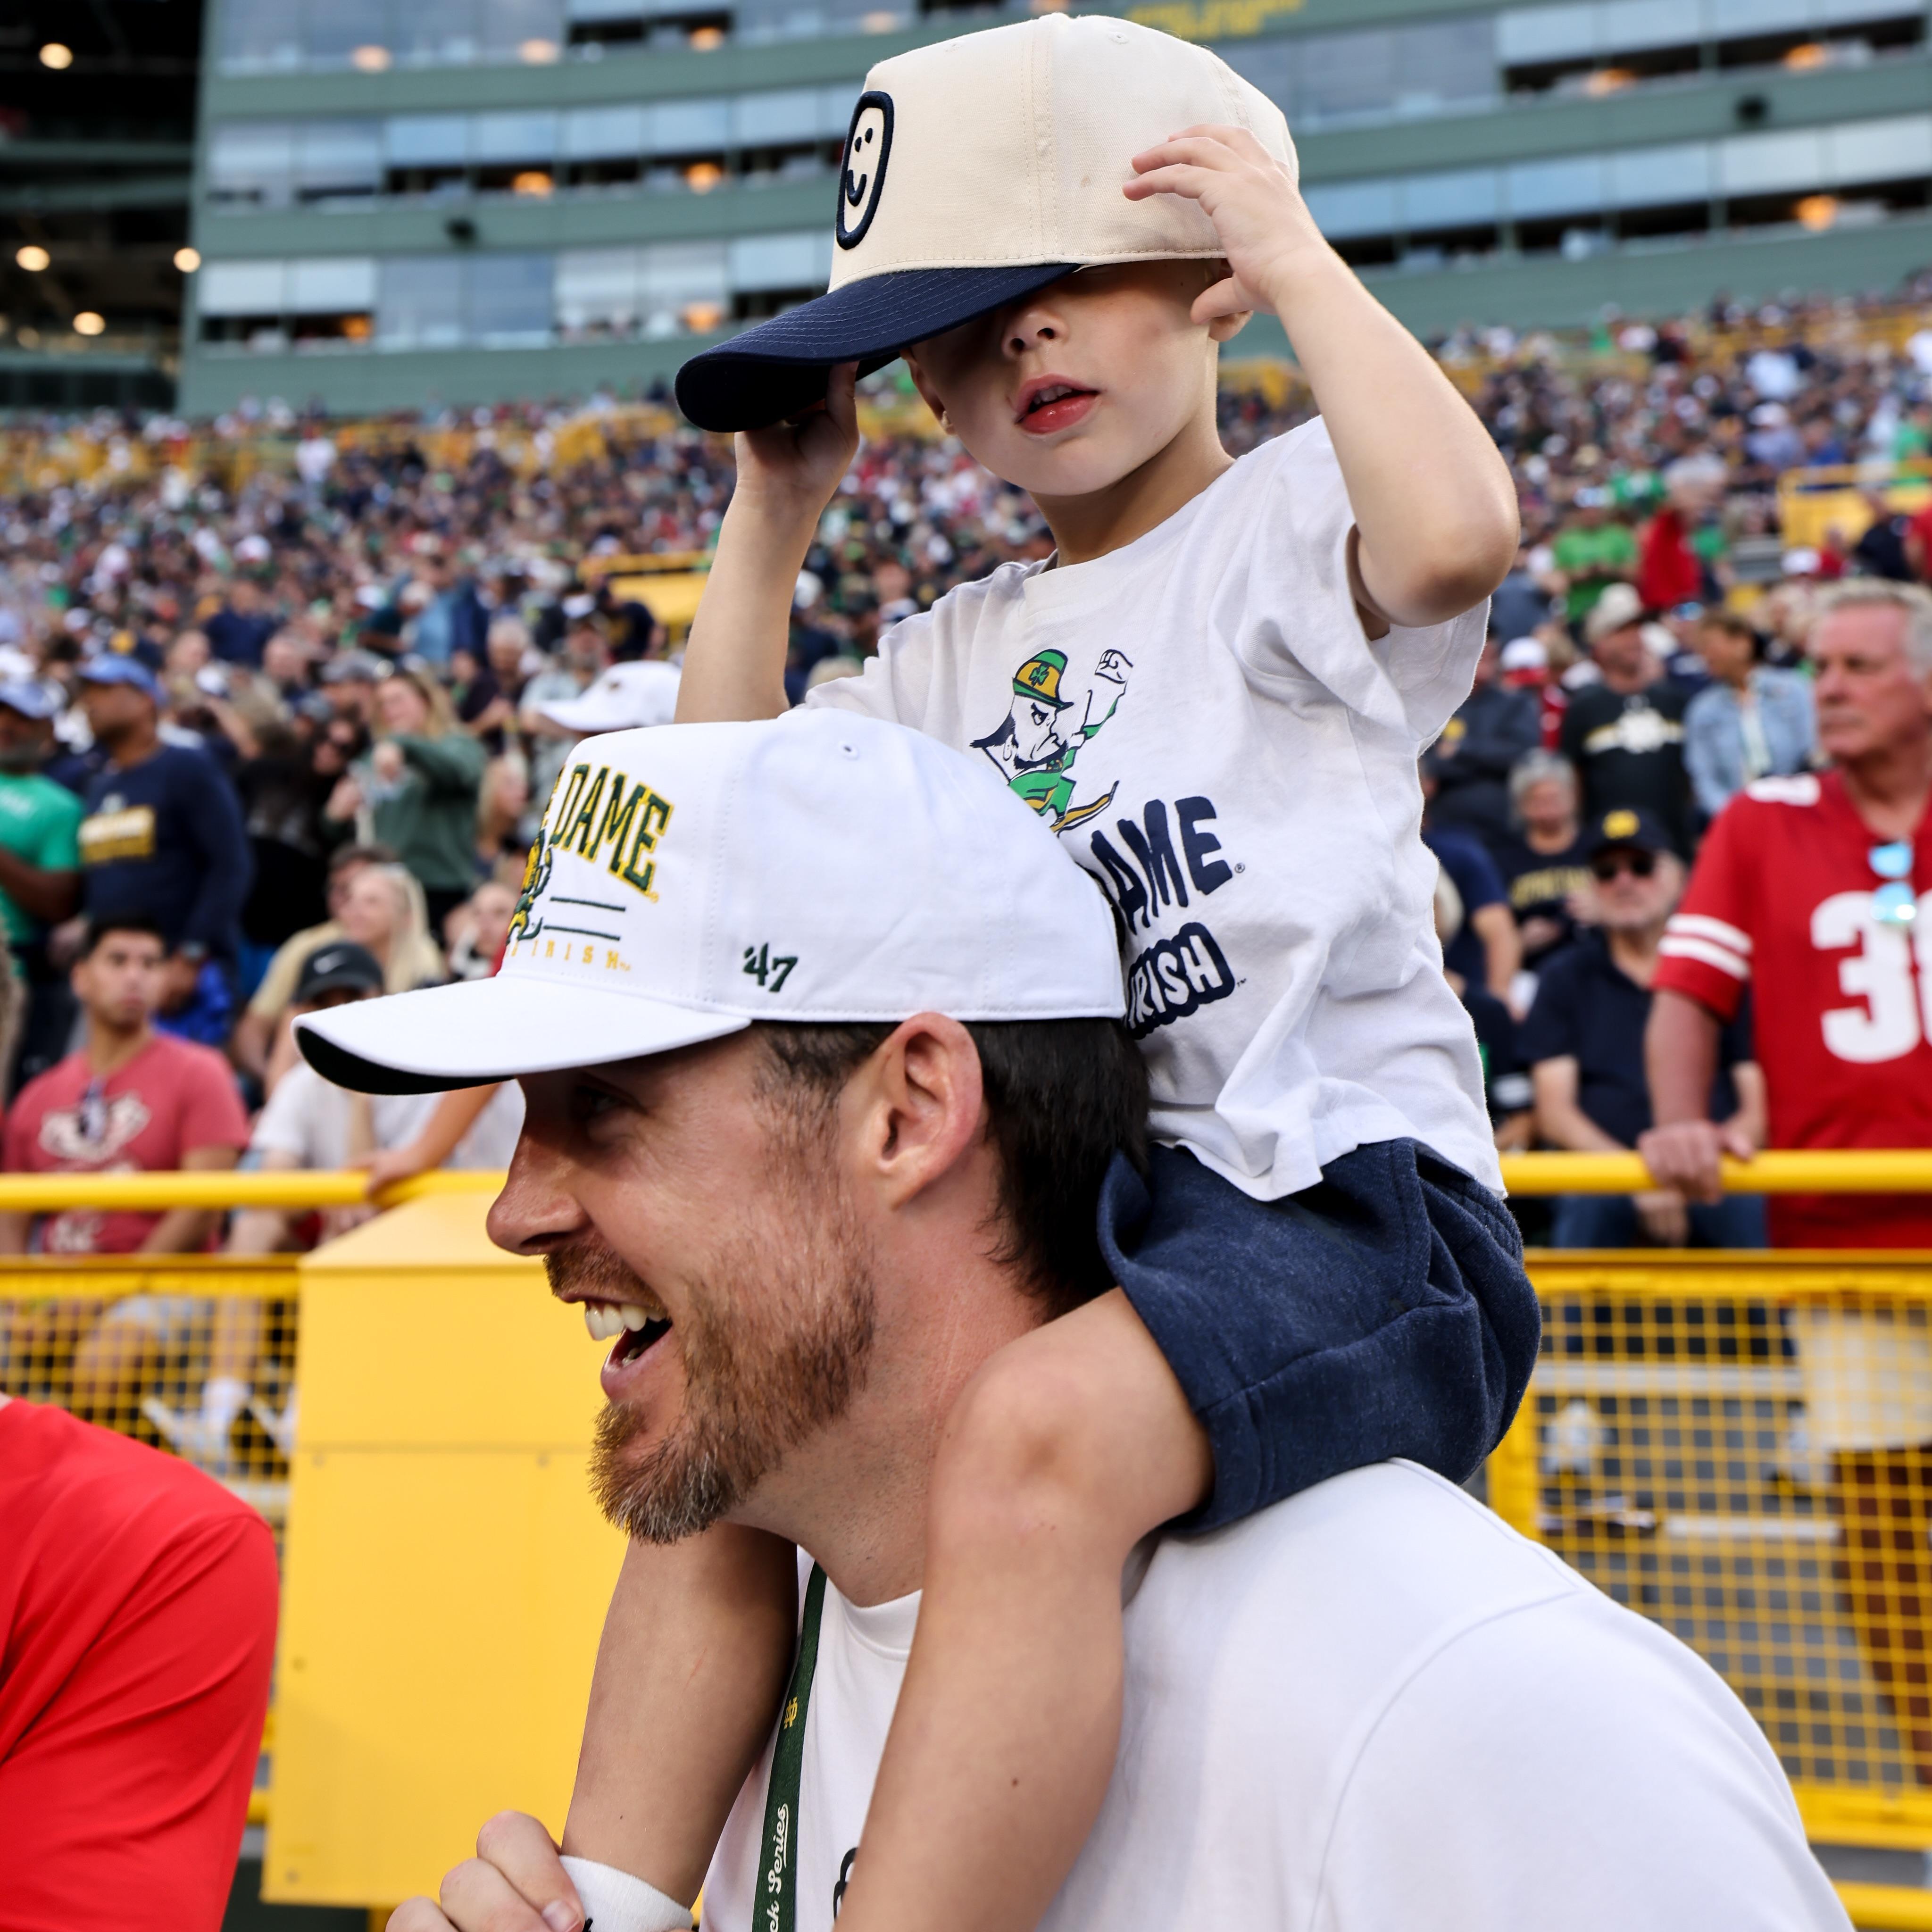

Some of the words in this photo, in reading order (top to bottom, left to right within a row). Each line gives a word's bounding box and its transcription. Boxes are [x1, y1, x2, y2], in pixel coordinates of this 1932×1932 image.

[548, 763, 674, 896] DAME
[531, 939, 620, 970] IRISH
[767, 1803, 789, 1895] Series
